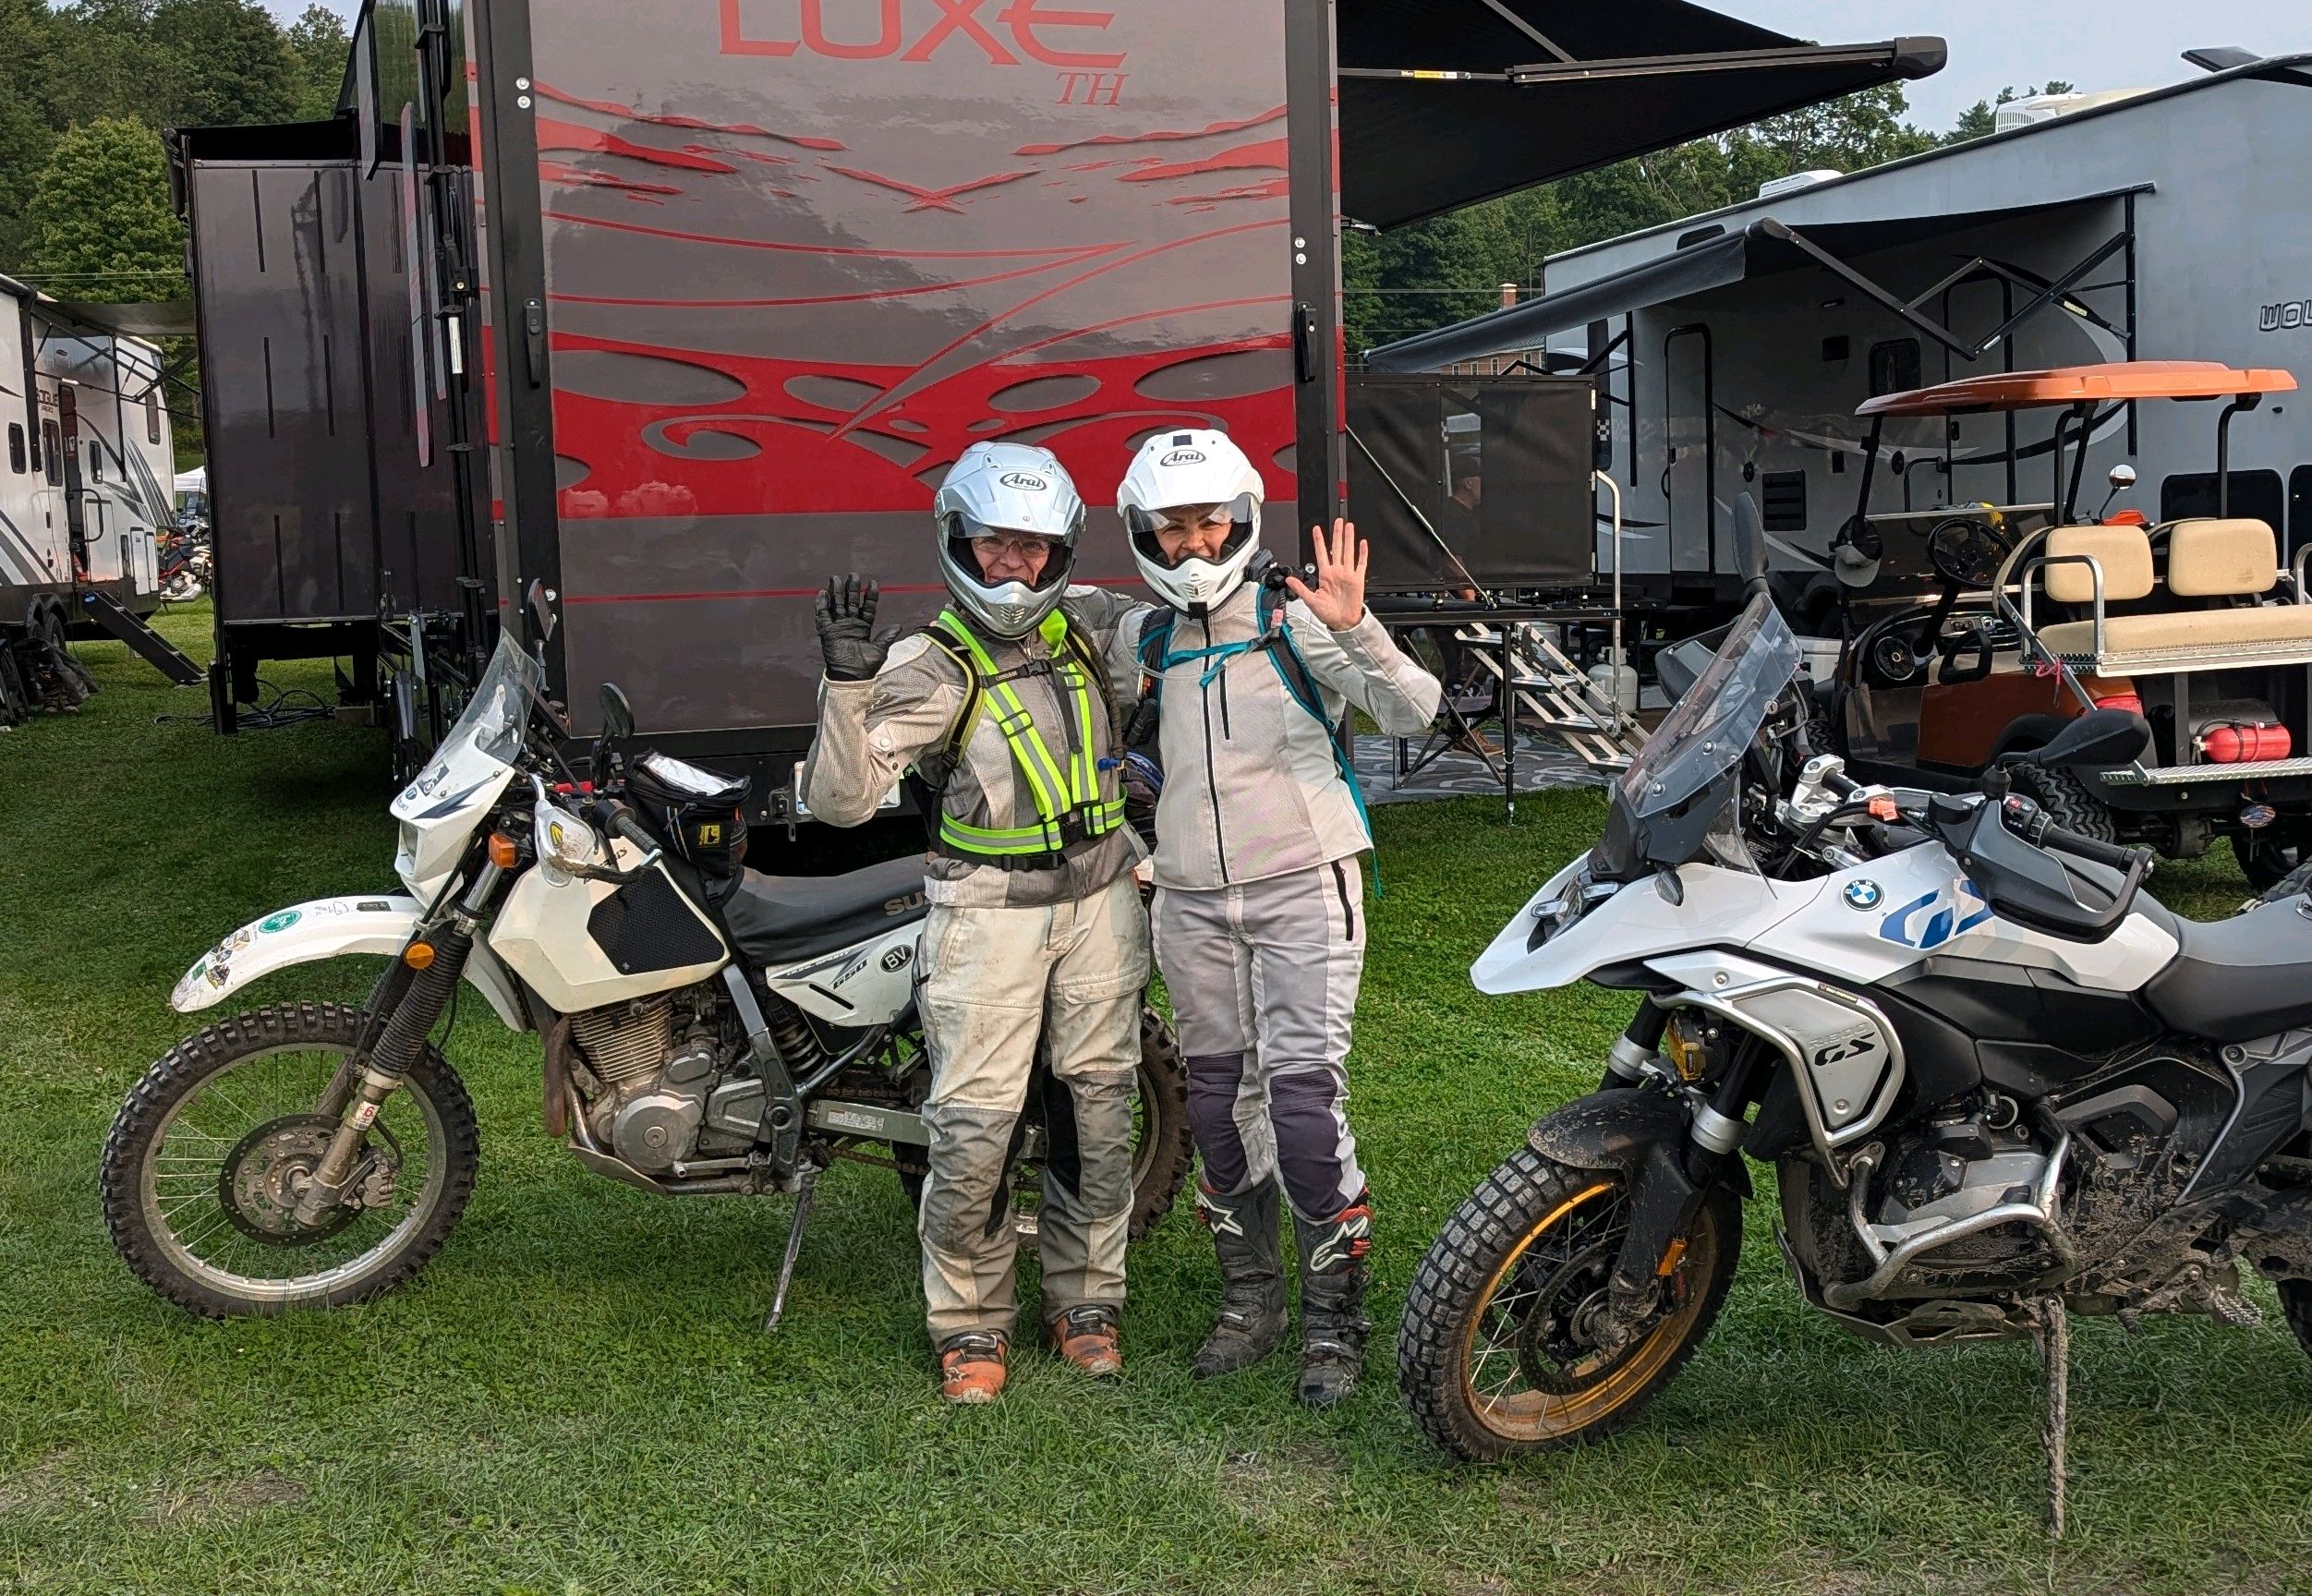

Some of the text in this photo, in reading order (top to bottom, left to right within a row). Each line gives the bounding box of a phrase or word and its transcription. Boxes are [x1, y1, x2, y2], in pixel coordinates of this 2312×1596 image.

[719, 0, 1128, 69] LUXE
[1055, 71, 1130, 107] TH
[1163, 450, 1201, 465] Arai
[1002, 474, 1042, 488] Arai
[884, 946, 908, 969] BV
[832, 958, 868, 990] 650
[1813, 1031, 1876, 1067] GS
